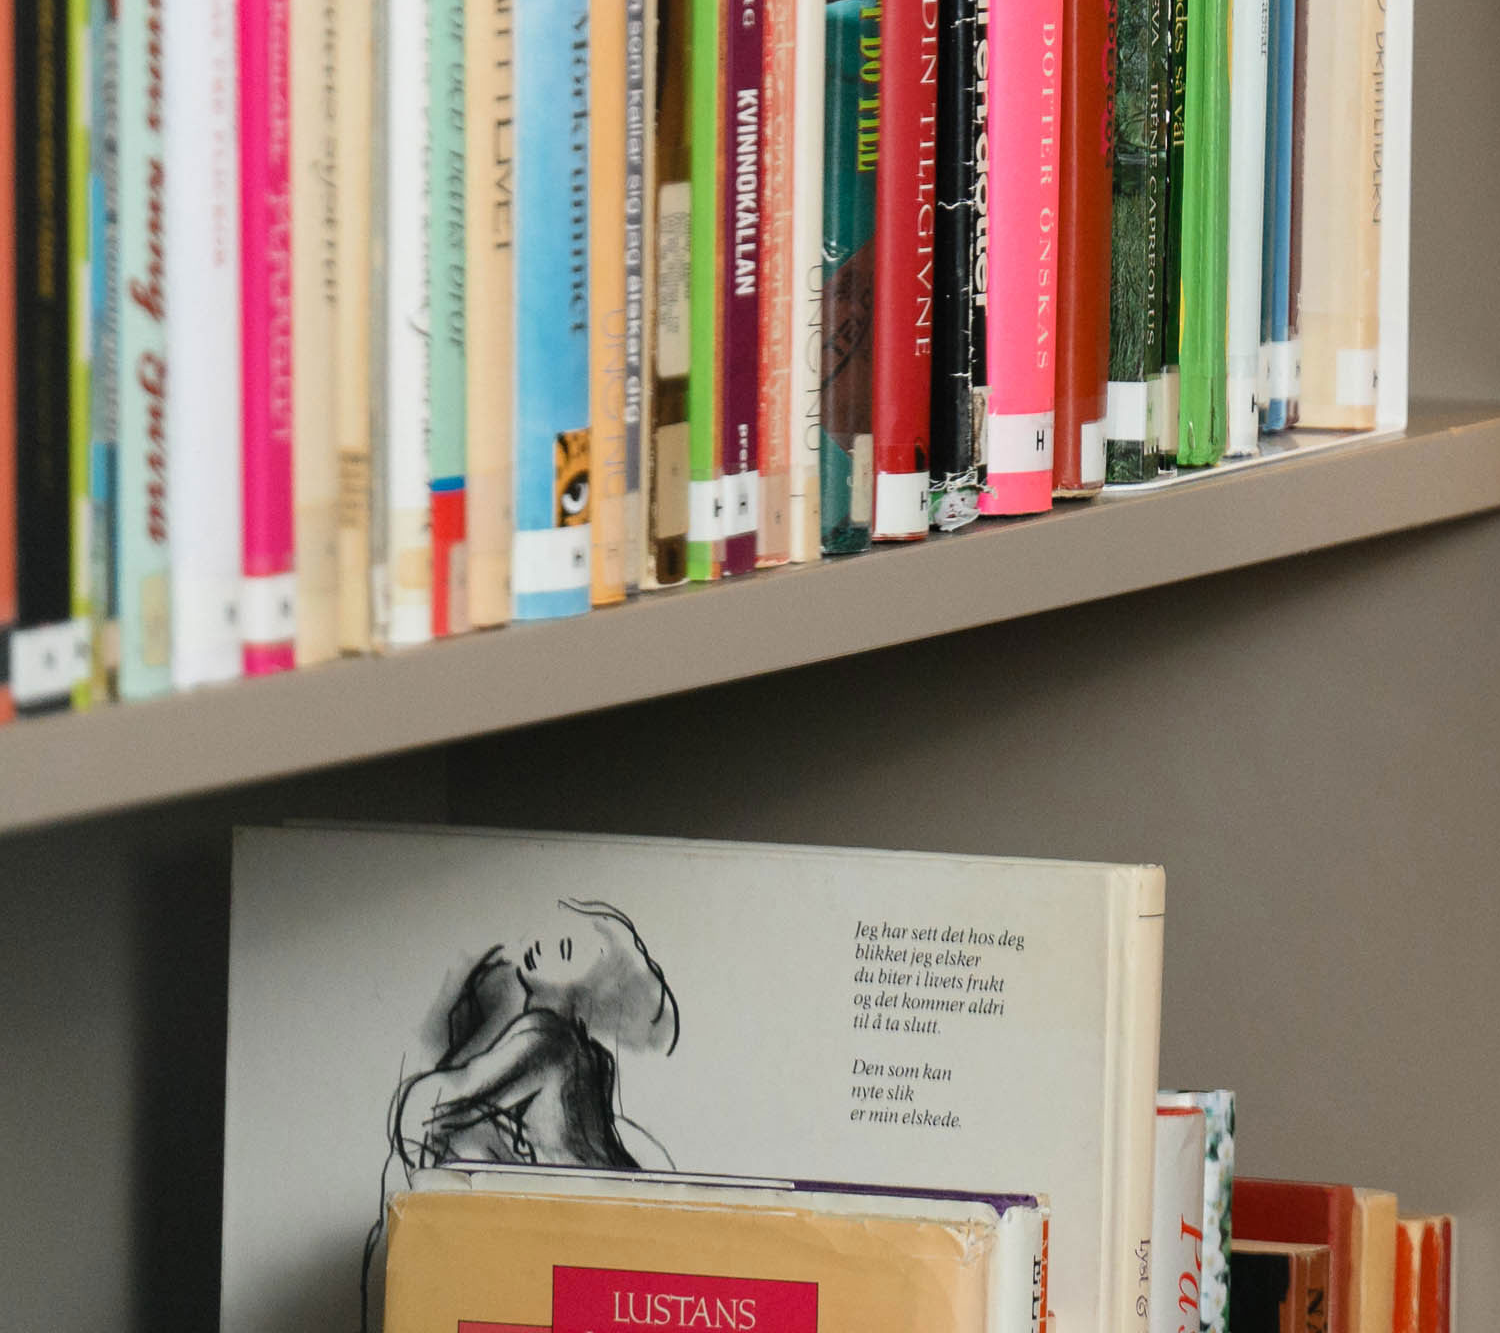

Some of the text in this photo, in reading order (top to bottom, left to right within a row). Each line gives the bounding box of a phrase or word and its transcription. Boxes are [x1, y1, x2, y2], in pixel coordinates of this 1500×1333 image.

[627, 20, 644, 80] som
[975, 38, 989, 121] en
[1175, 64, 1188, 95] så
[1040, 21, 1056, 184] DOTTER
[627, 88, 644, 165] kallar
[1172, 103, 1186, 146] väl
[623, 173, 642, 215] sig
[735, 88, 760, 296] KVINNOKÄLLAN
[914, 102, 936, 357] TILLGIVNE
[974, 131, 991, 316] dotter
[623, 224, 642, 266] jag
[1147, 175, 1158, 346] CAPREOLUS
[1036, 206, 1053, 371] ÖNSKAS
[623, 376, 642, 425] dig
[1036, 429, 1046, 452] H
[854, 921, 1025, 950] Jeg har sett det hos deg
[855, 944, 982, 968] blikket jeg elsker
[854, 967, 874, 983] du
[878, 968, 913, 986] biter
[924, 972, 963, 989] livets
[965, 974, 1004, 993] frukt
[853, 991, 1004, 1015] og det kommer aldri
[853, 1012, 941, 1034] til å ta slutt.
[852, 1059, 952, 1081] Den som kan
[851, 1085, 914, 1102] nyte slik
[850, 1107, 961, 1128] er min elskede.
[1134, 1238, 1151, 1288] Lyst
[612, 1290, 758, 1330] LUSTANS
